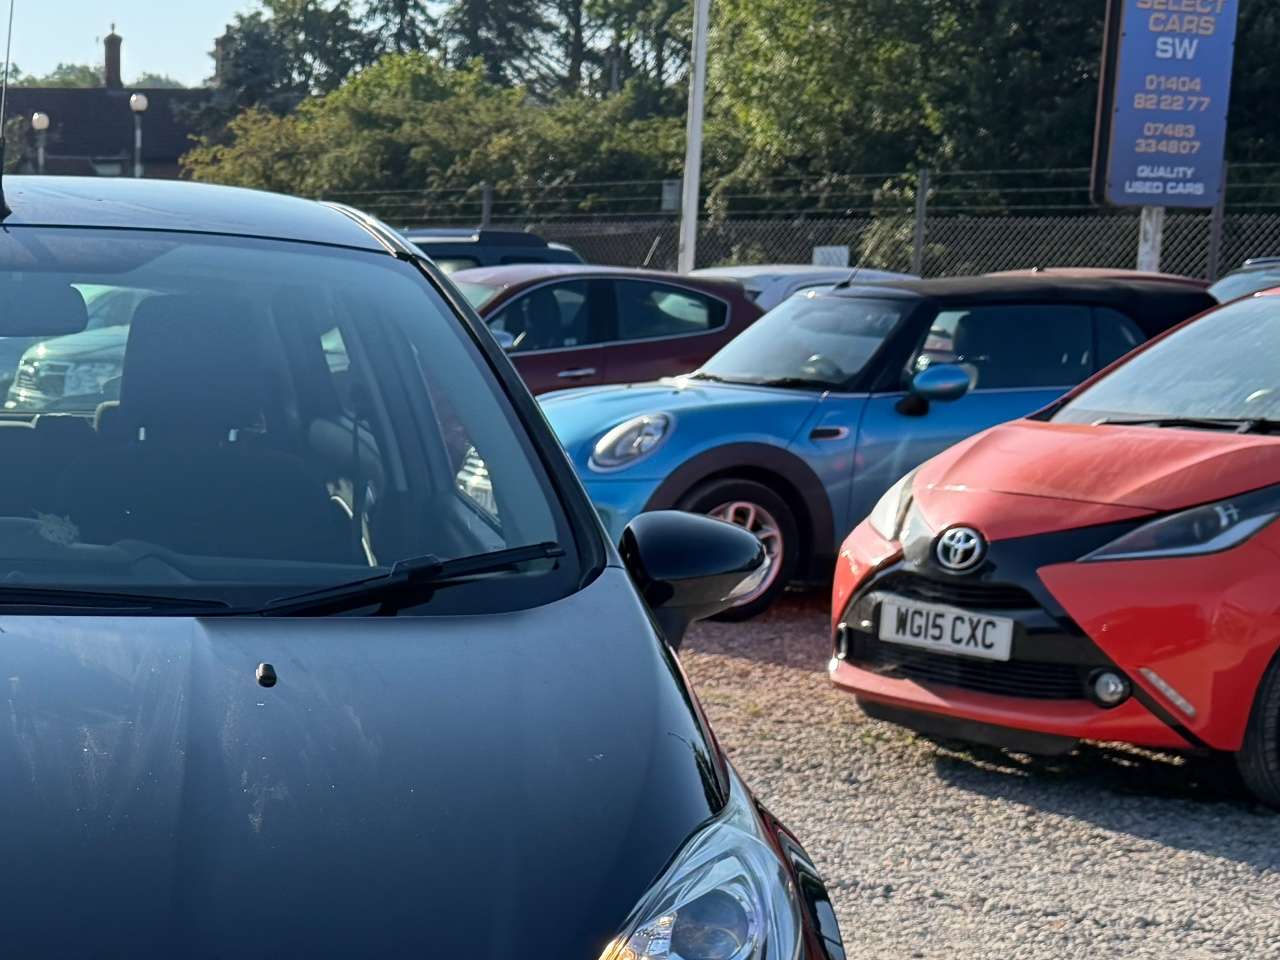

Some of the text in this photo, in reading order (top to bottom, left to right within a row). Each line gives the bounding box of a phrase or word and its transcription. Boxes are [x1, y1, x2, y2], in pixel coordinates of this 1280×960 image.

[1148, 13, 1216, 35] CARS
[1155, 36, 1199, 60] SW
[1145, 74, 1201, 92] 01404
[1137, 164, 1194, 178] QUALITY
[1124, 180, 1205, 195] USED CARS
[894, 607, 996, 649] WG15 CXC
